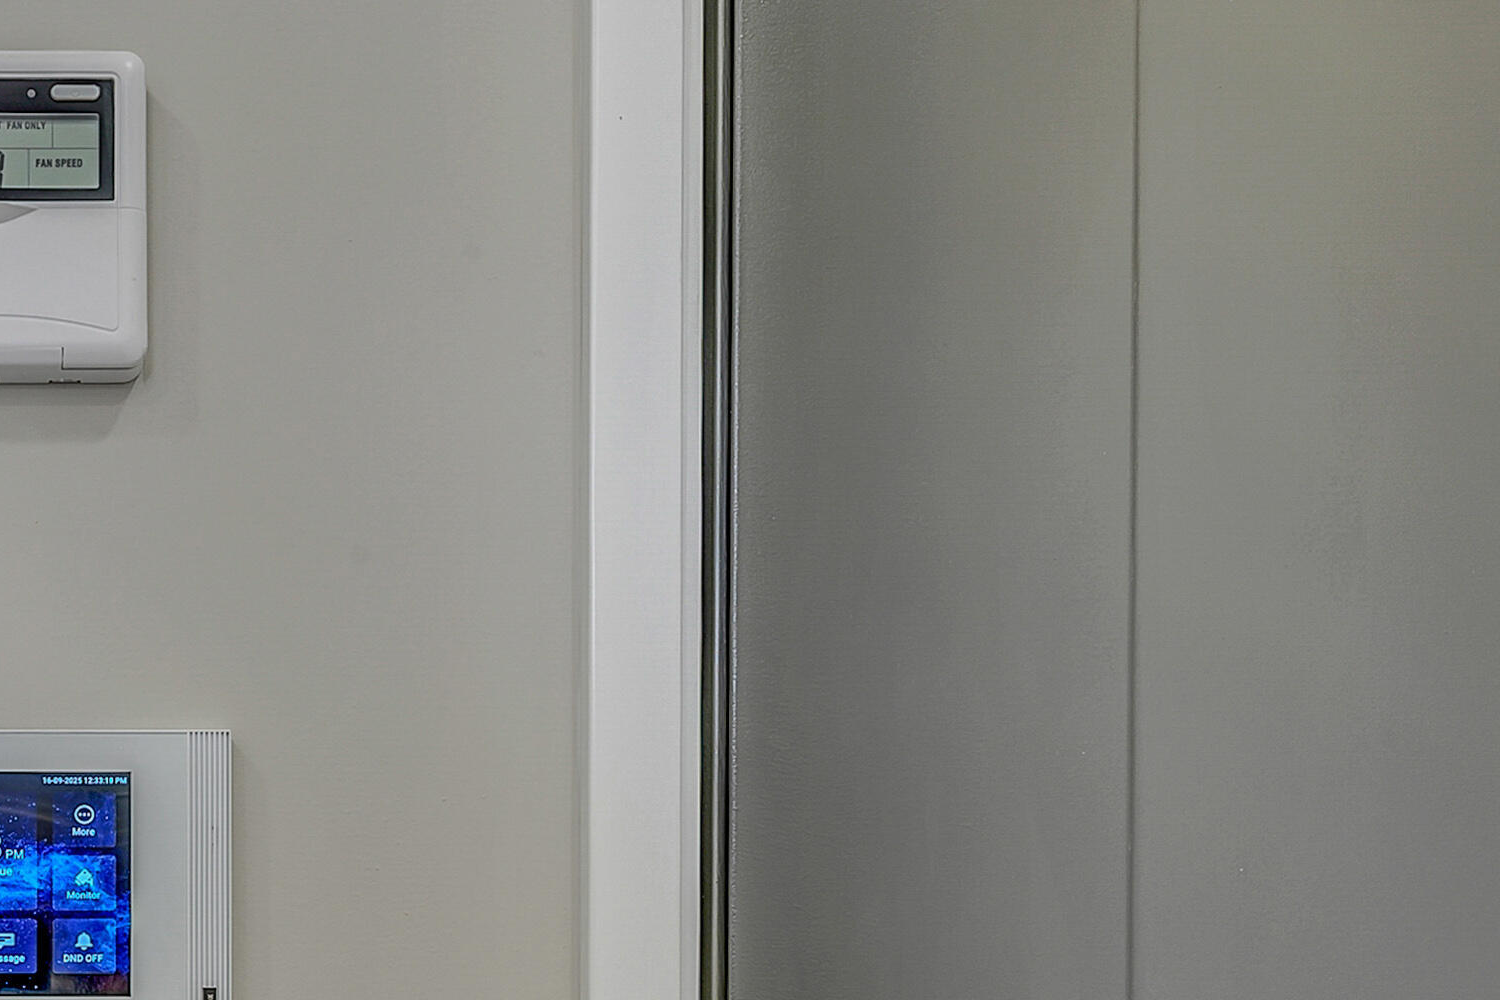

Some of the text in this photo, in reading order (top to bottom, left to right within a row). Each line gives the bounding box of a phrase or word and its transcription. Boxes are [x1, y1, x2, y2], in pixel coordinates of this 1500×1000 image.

[6, 121, 23, 130] FAN
[24, 121, 46, 130] ONLY
[35, 158, 83, 169] FAN SPEED
[115, 776, 128, 784] PM
[71, 827, 96, 837] More
[5, 849, 24, 860] PM
[66, 890, 101, 900] Monitor
[63, 953, 103, 963] DND OFF
